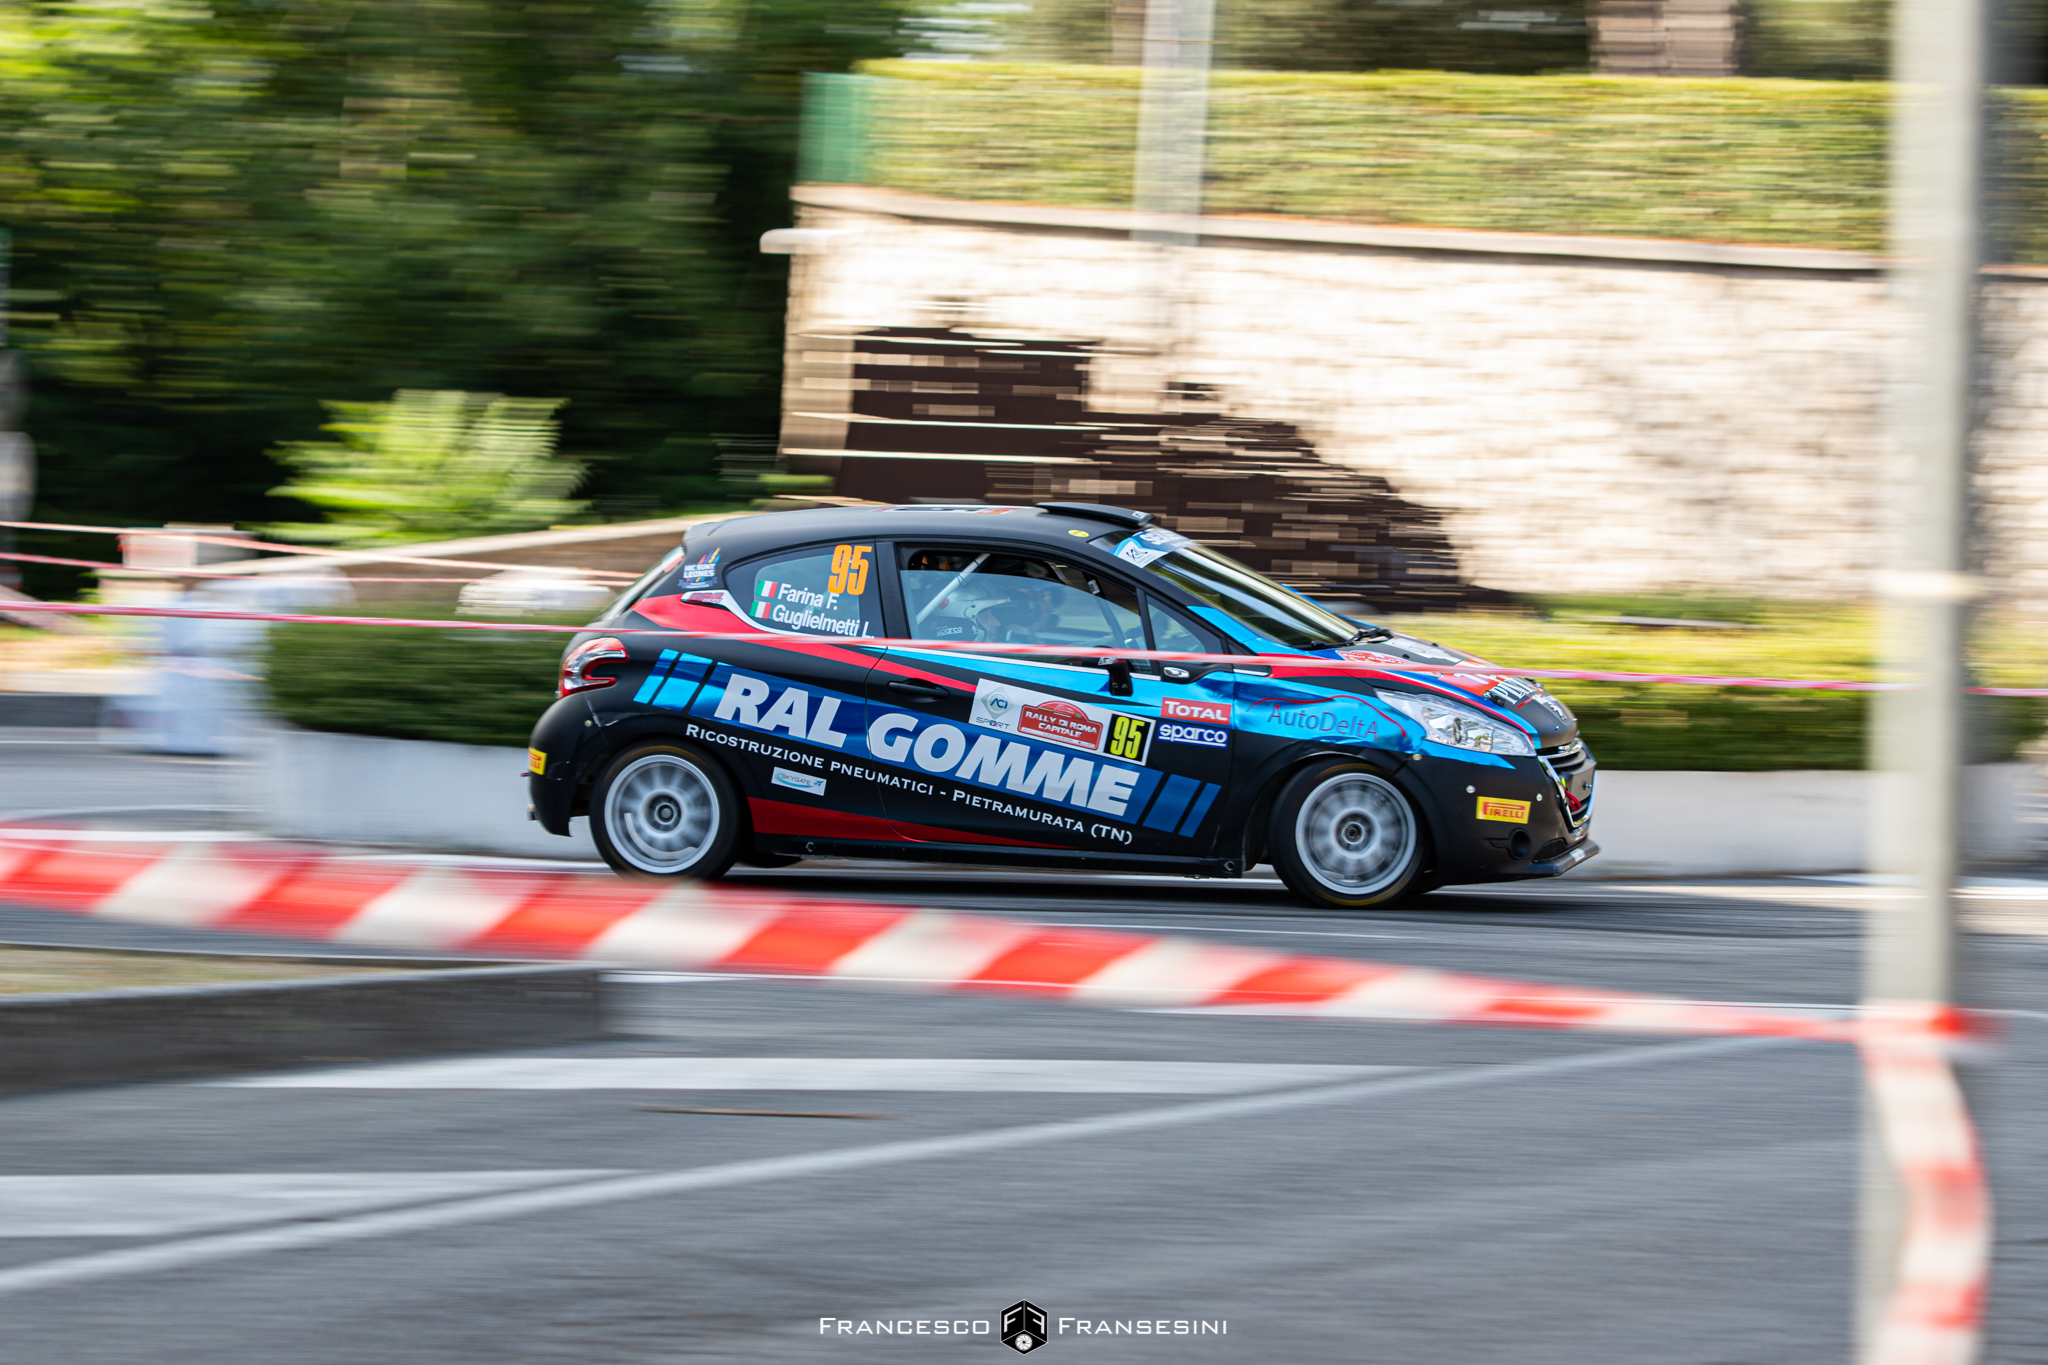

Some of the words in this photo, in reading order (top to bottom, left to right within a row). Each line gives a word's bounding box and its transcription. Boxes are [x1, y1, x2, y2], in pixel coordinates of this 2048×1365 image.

[683, 570, 715, 578] LEONES
[828, 544, 872, 595] 95
[777, 583, 824, 607] Farina
[826, 593, 839, 610] F.
[772, 604, 860, 636] Guglielmetti
[862, 621, 874, 638] L.
[990, 697, 1008, 709] ACI
[1164, 700, 1228, 721] TOTAL
[976, 716, 1010, 730] SPORT
[1025, 710, 1057, 723] RALLY
[1059, 718, 1067, 727] DI
[1070, 721, 1098, 733] ROMA
[1038, 722, 1082, 738] CAPITALE
[1267, 704, 1379, 740] AutoDeltA
[714, 673, 847, 748] RAL
[866, 713, 1140, 817] GOMME
[1110, 716, 1145, 759] 95
[1159, 723, 1227, 745] sparco
[685, 723, 825, 769] RICOSTRUZIONE
[830, 761, 933, 796] PNEUMATICI
[952, 789, 1084, 833] PIETRAMURATA
[1090, 823, 1133, 845] (TN)
[781, 773, 811, 786] SKYGATE
[1482, 801, 1525, 819] PIRELLI
